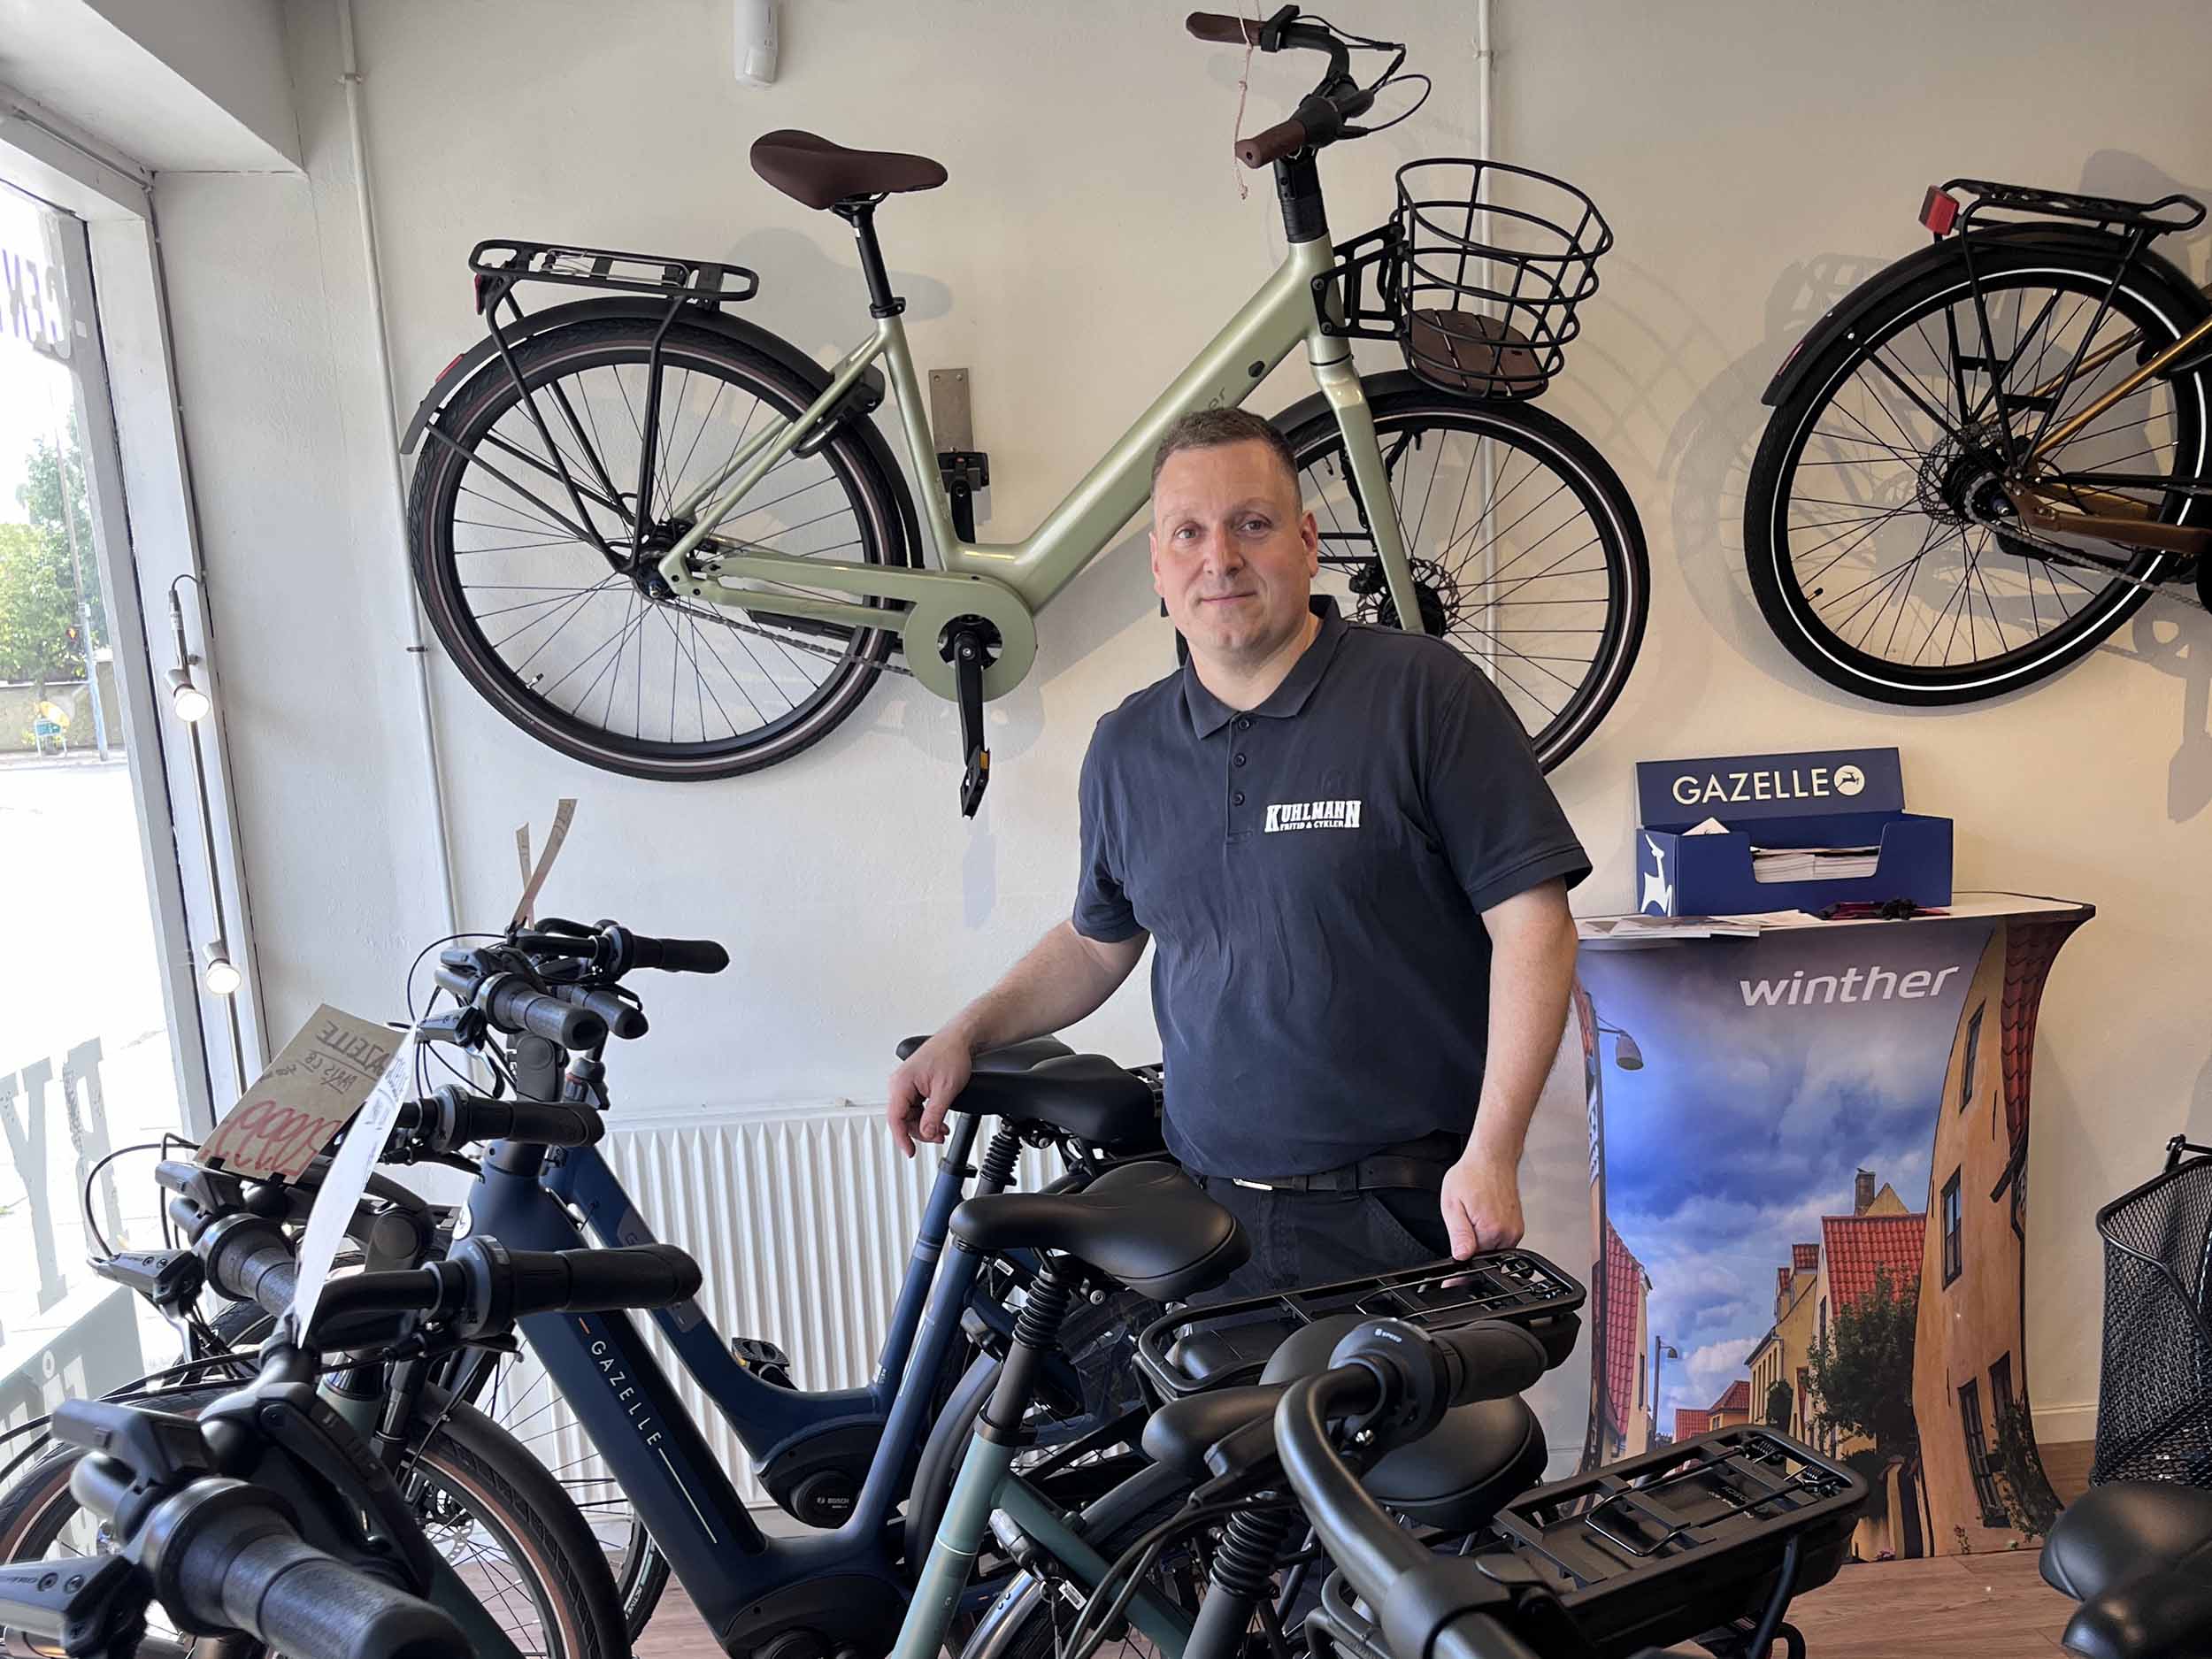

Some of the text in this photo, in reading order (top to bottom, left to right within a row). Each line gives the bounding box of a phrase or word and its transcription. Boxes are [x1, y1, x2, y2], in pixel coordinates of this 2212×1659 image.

[1671, 768, 1831, 805] GAZELLE
[1263, 800, 1363, 833] KUHLMANN
[1313, 819, 1345, 829] CYKLER
[1740, 965, 1961, 1007] winther
[591, 1340, 663, 1447] GAZELLE
